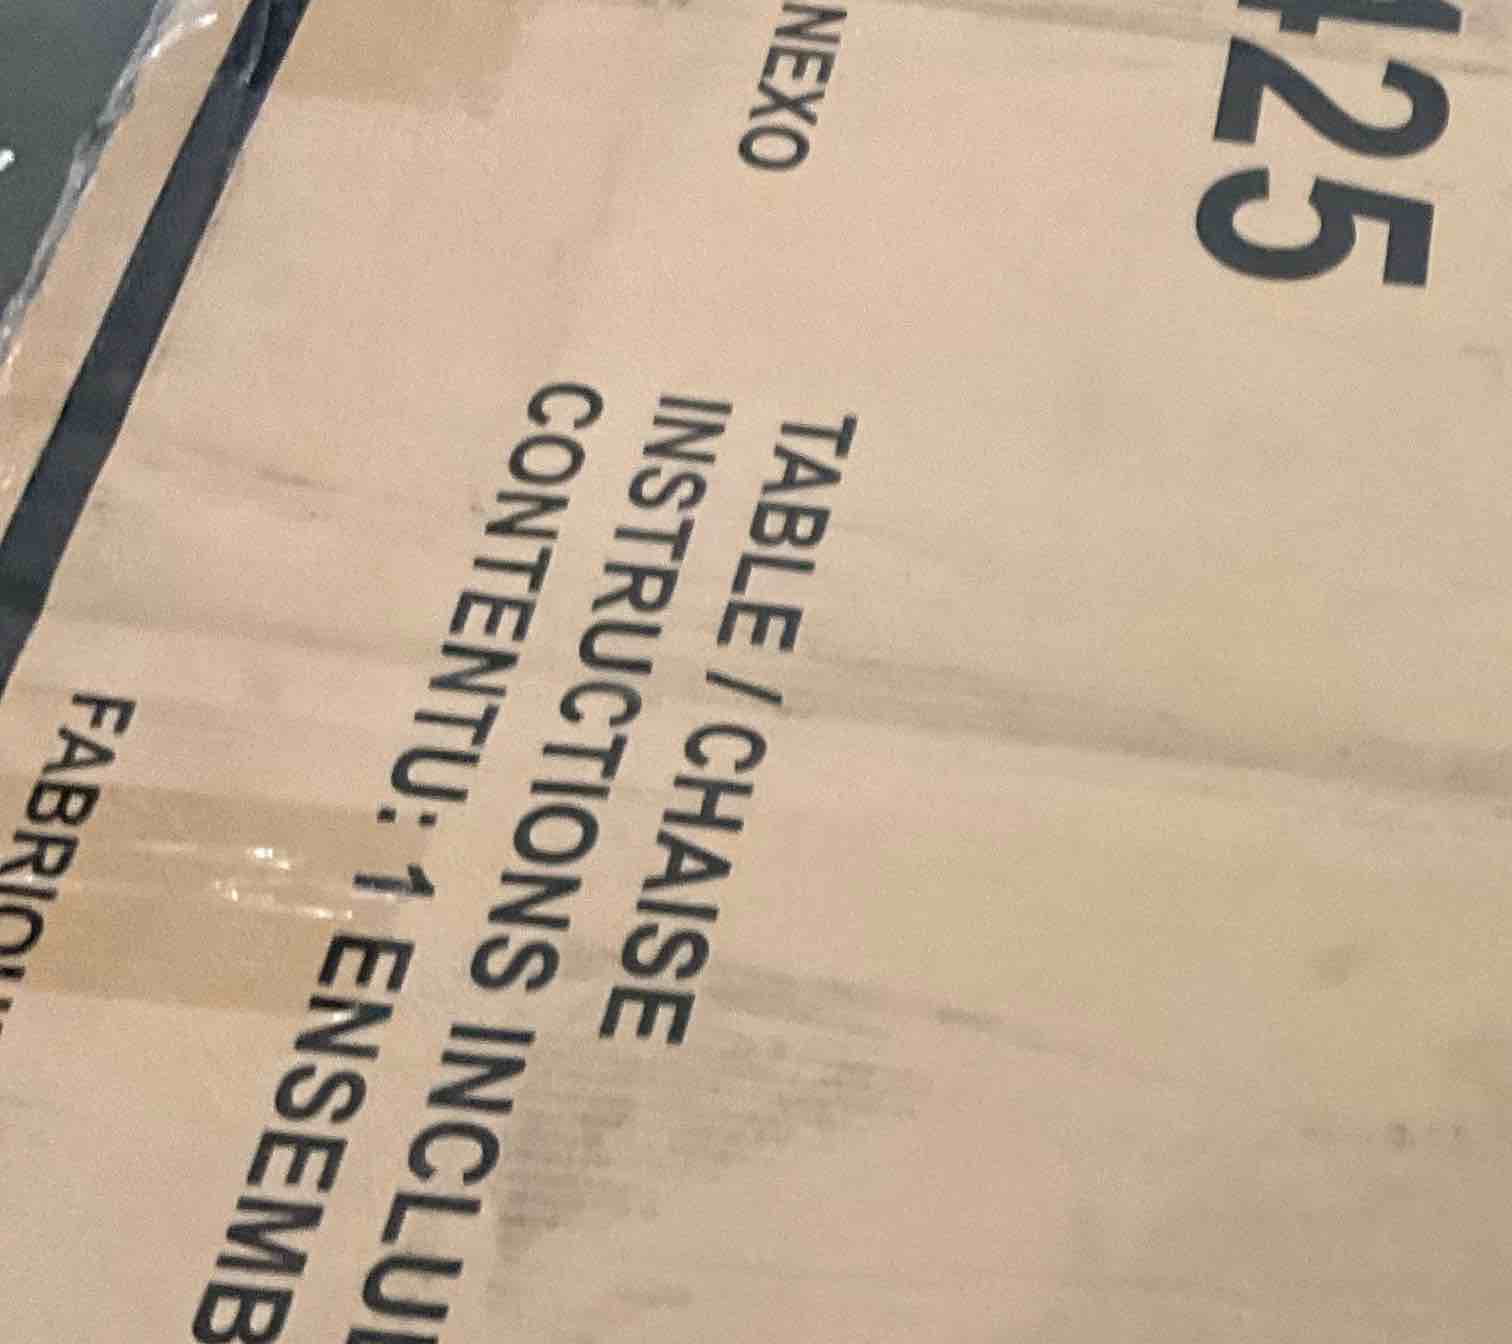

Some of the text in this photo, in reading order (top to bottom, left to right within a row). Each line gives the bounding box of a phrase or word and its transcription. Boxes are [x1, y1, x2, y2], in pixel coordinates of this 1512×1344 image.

[378, 381, 604, 827] CONTENTU:
[469, 394, 733, 997] INSTRUCTIONS
[598, 410, 858, 1049] TABLE / CHAISE
[0, 690, 136, 1036] FABRI
[352, 864, 436, 900] 1
